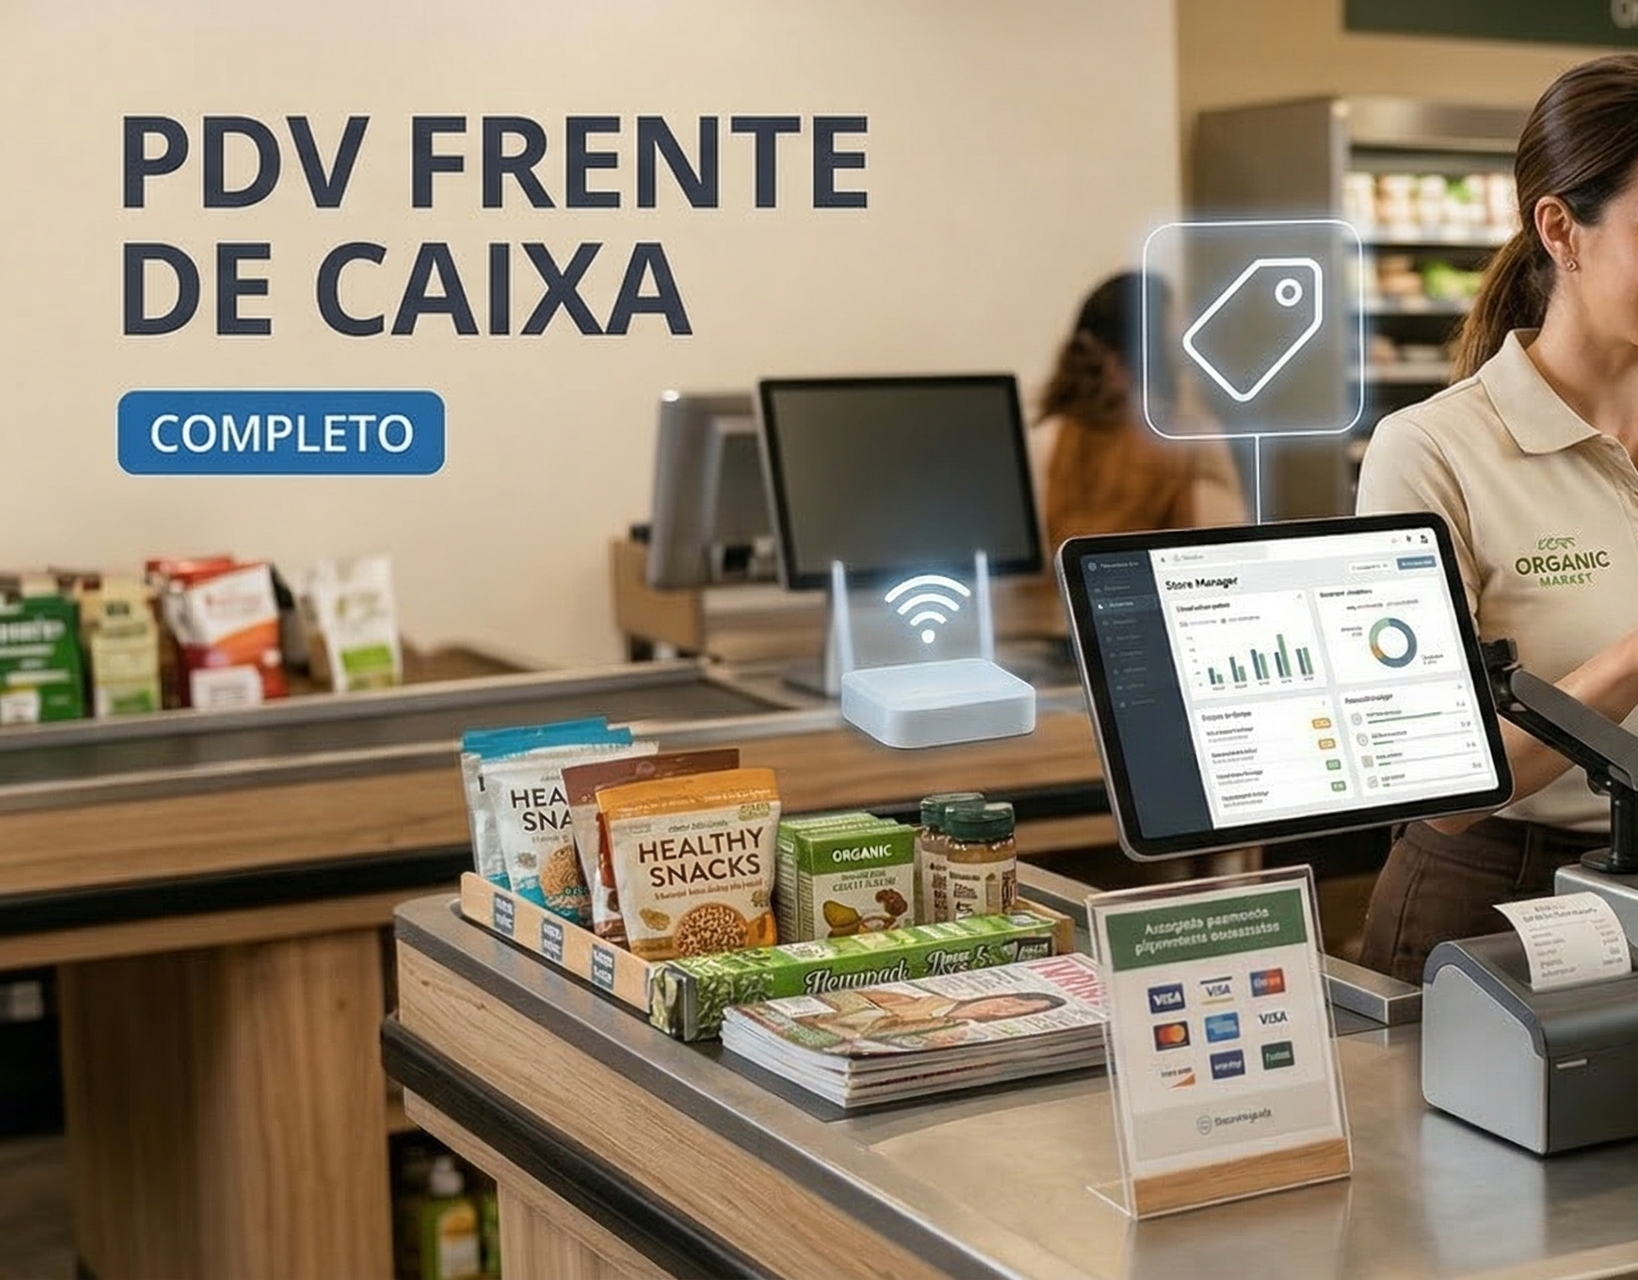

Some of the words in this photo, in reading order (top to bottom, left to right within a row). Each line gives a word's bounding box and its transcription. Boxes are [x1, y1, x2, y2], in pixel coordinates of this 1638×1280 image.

[1515, 551, 1611, 575] ORGANIC
[638, 826, 764, 864] HEALTHY
[832, 843, 893, 863] ORGANIC
[649, 853, 762, 888] SNACKS
[1153, 990, 1182, 1006] VISA
[1205, 984, 1231, 997] VISA
[1258, 1010, 1288, 1025] VISA
